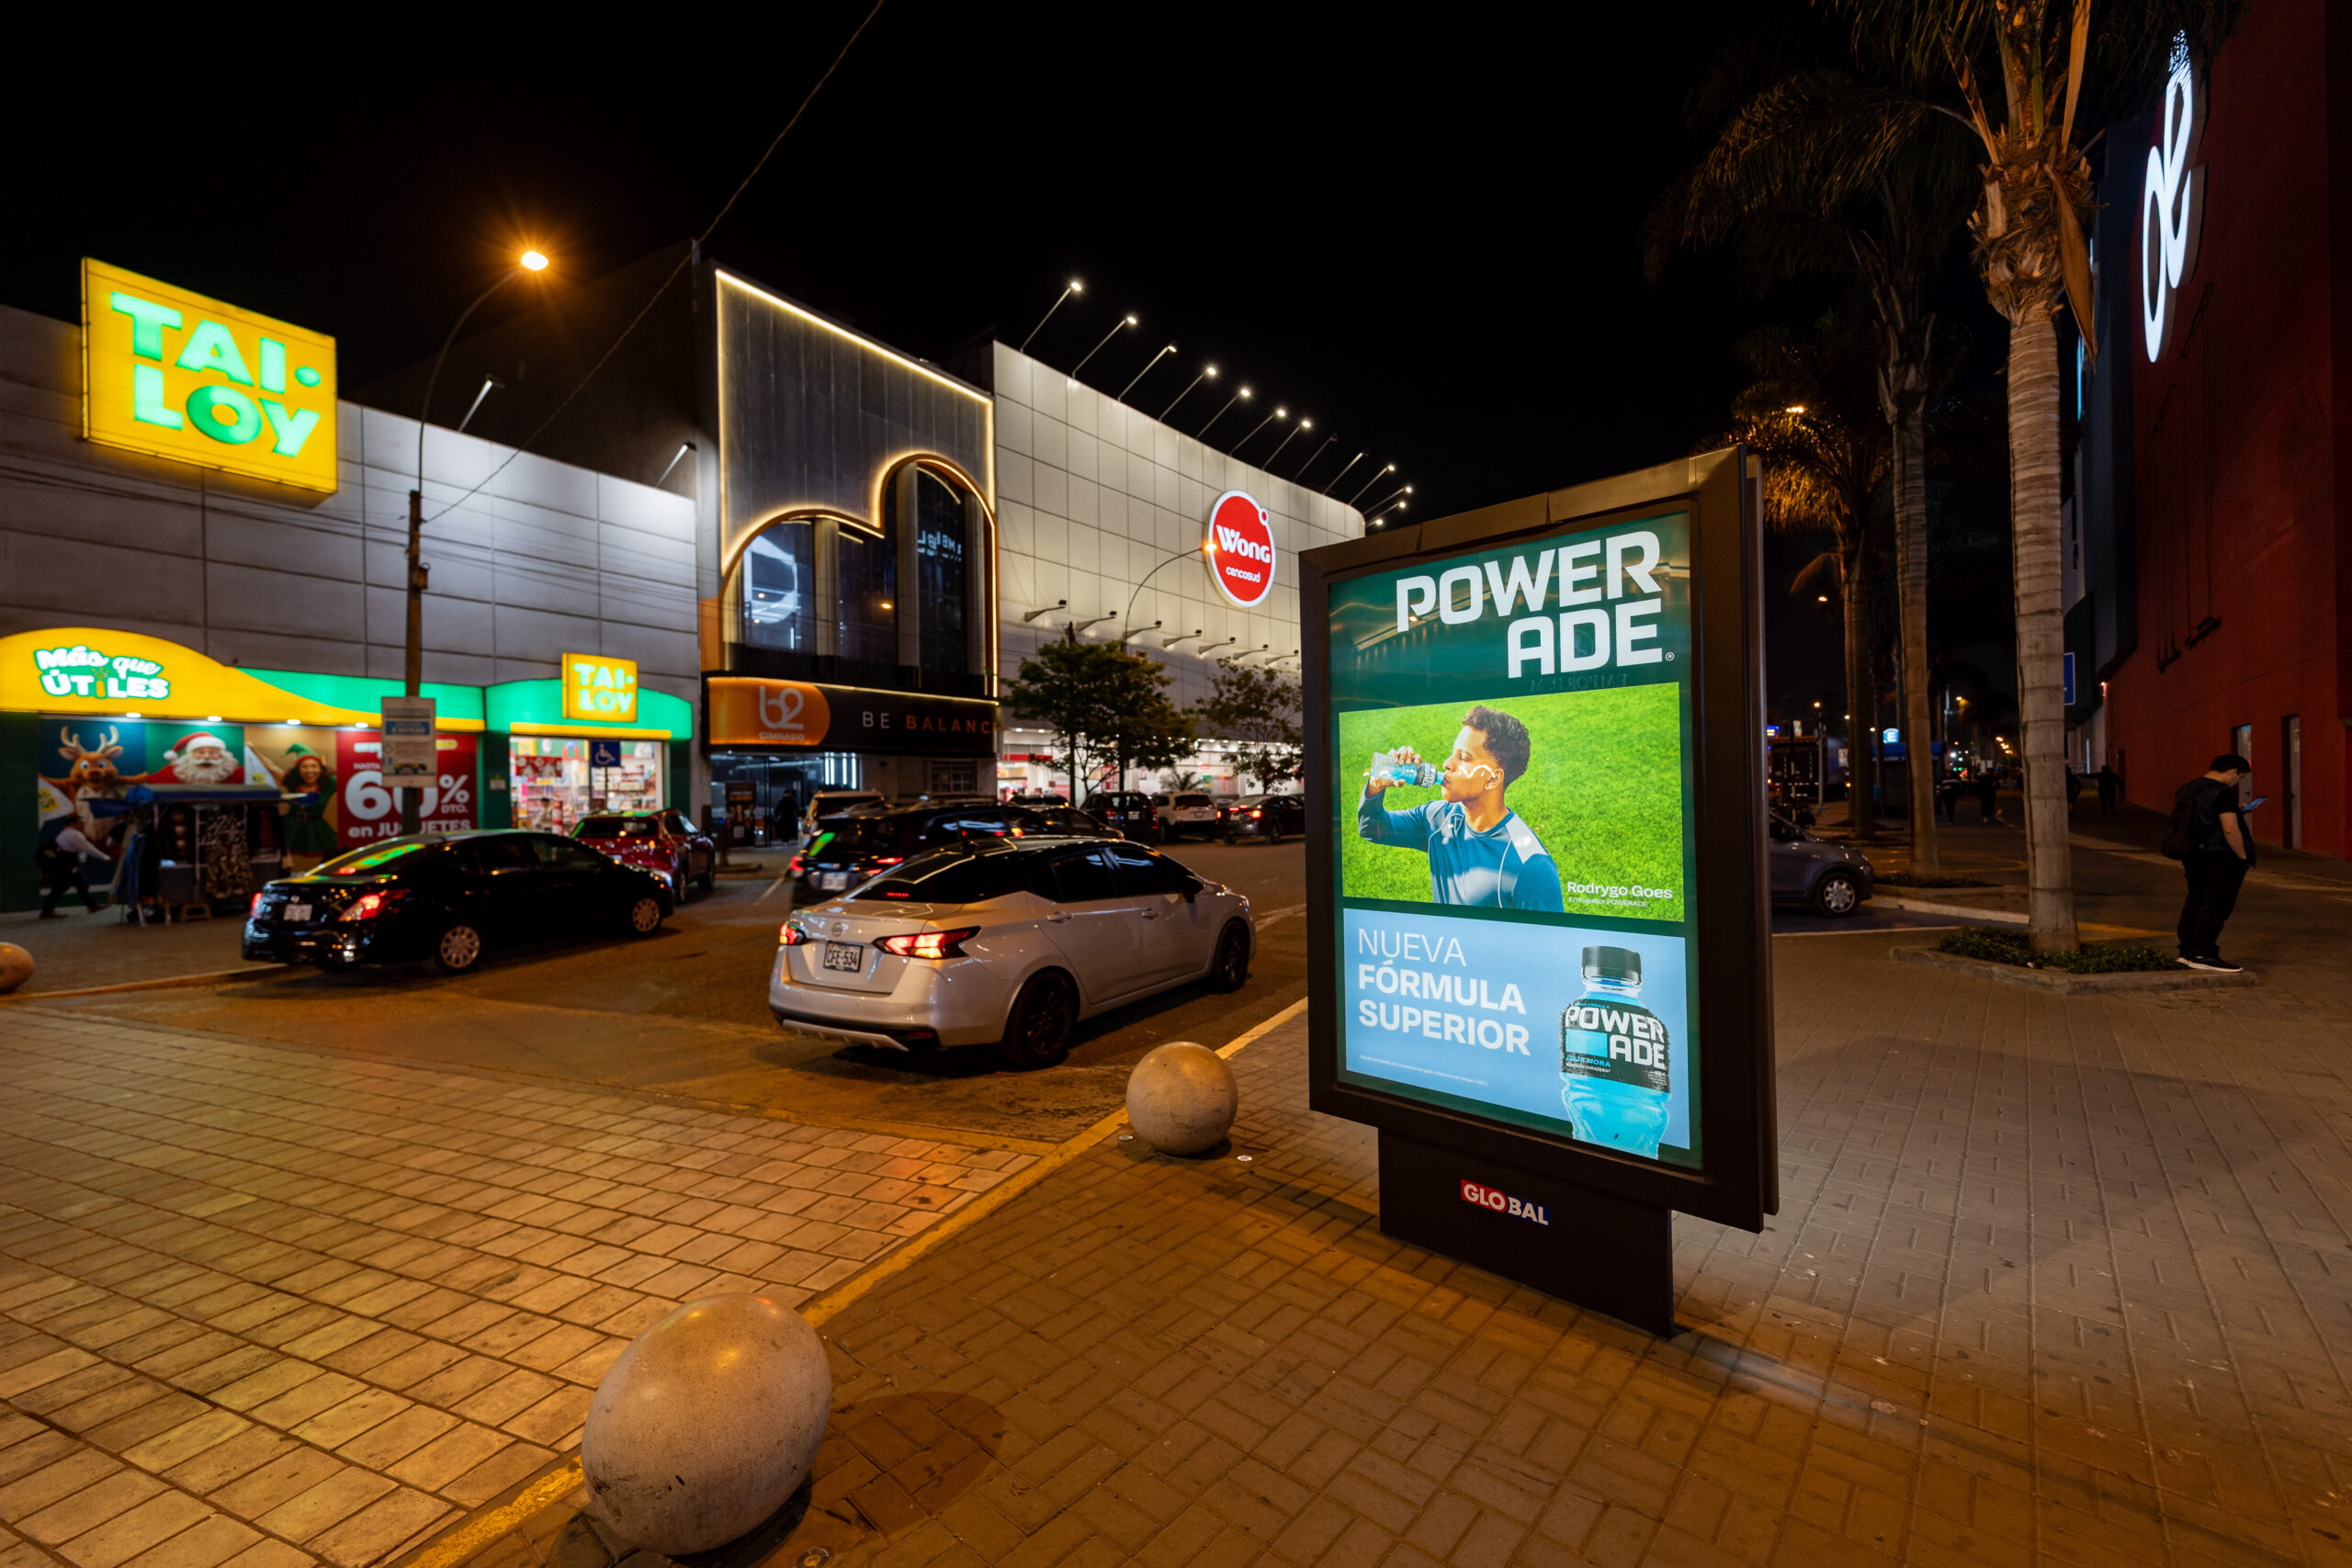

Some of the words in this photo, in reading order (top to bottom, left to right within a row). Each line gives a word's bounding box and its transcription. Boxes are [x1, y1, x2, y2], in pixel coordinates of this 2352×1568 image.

[133, 363, 321, 457] LOY
[1226, 566, 1261, 583] cencosud
[1396, 530, 1662, 632] POWER
[36, 645, 109, 670] Más
[112, 656, 163, 680] que
[579, 689, 634, 713] LOY
[862, 711, 890, 728] BE
[759, 732, 805, 741] GIMNASIO
[441, 805, 469, 814] DTO.
[348, 825, 373, 838] en
[1567, 882, 1628, 898] Rodrygo
[1631, 885, 1672, 899] Goes
[1568, 896, 1605, 905] Embajador
[1607, 898, 1648, 908] POWERADE
[1359, 928, 1467, 967] NUEVA
[1359, 959, 1527, 1014] FÓRMULA
[1359, 999, 1532, 1056] SUPERIOR
[1566, 1006, 1665, 1043] POWER
[1586, 1058, 1611, 1067] MORA
[1610, 1034, 1666, 1070] ADE
[1464, 1184, 1549, 1226] GLOBAL
